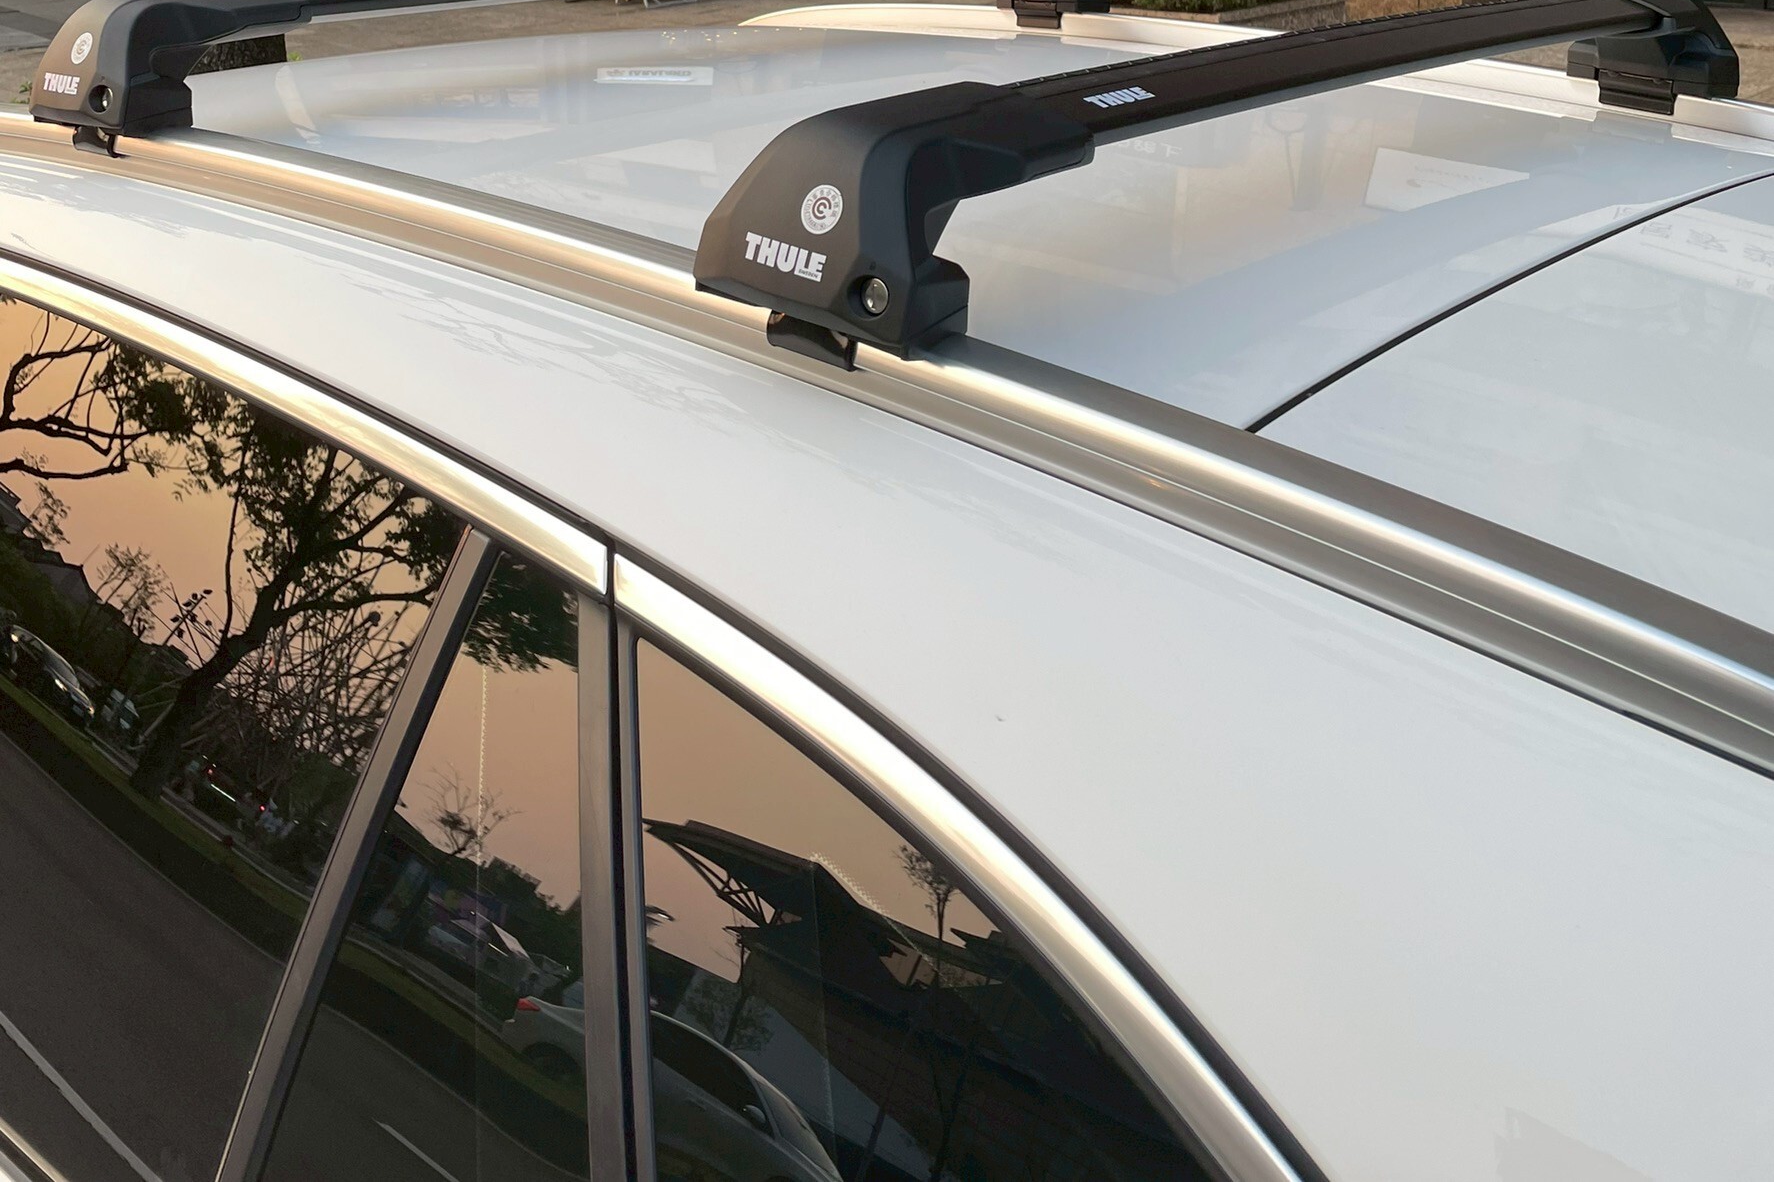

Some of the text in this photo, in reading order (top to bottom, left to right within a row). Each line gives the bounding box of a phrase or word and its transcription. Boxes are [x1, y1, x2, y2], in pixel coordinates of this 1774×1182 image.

[43, 72, 80, 95] THULE
[1082, 86, 1156, 108] THULE
[745, 231, 827, 283] THULE
